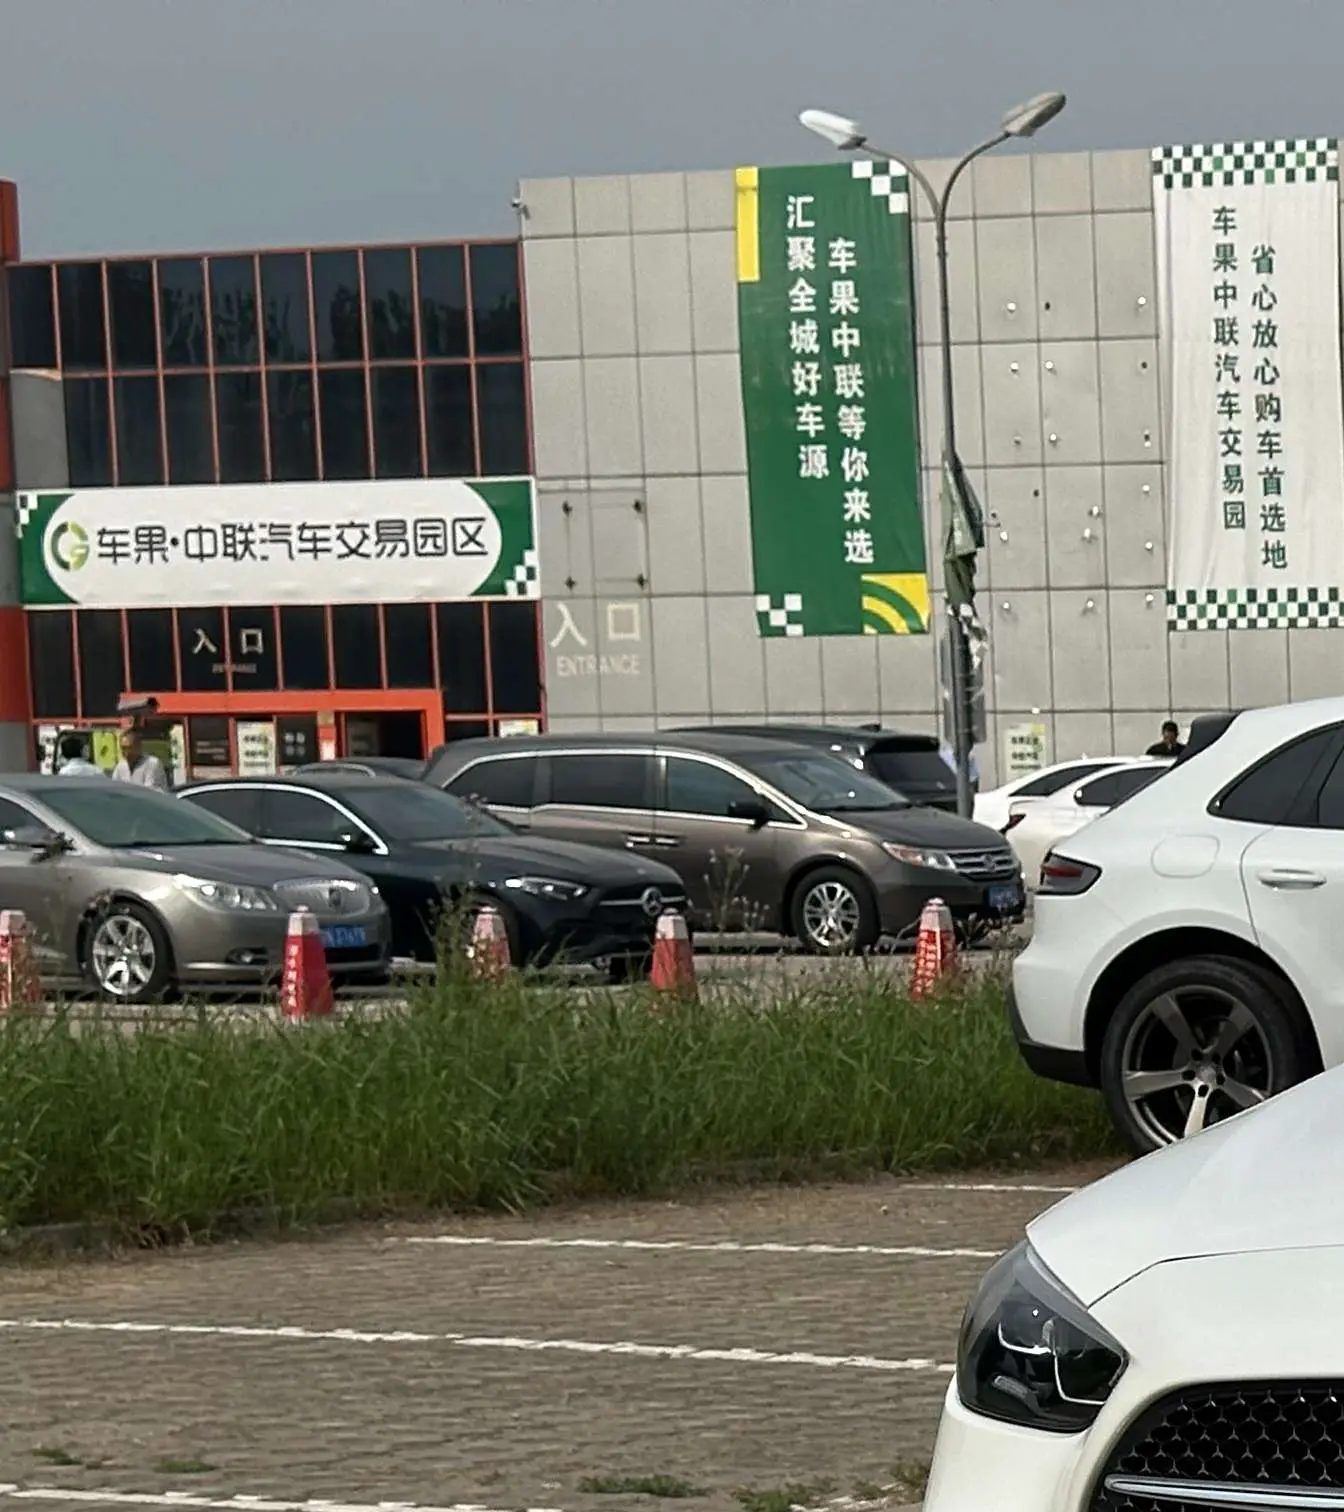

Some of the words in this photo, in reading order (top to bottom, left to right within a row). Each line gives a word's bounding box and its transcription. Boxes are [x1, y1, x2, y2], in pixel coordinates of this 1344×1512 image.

[785, 194, 829, 480] 汇聚全城好车源
[828, 237, 874, 564] 车果中联等你来选
[1212, 205, 1246, 530] 车果中联汽车交易园
[1251, 245, 1288, 569] 省心放心购车首选地
[96, 516, 489, 564] 车果·中联汽车交易园区
[192, 628, 264, 655] 入口
[550, 602, 641, 648] 入口
